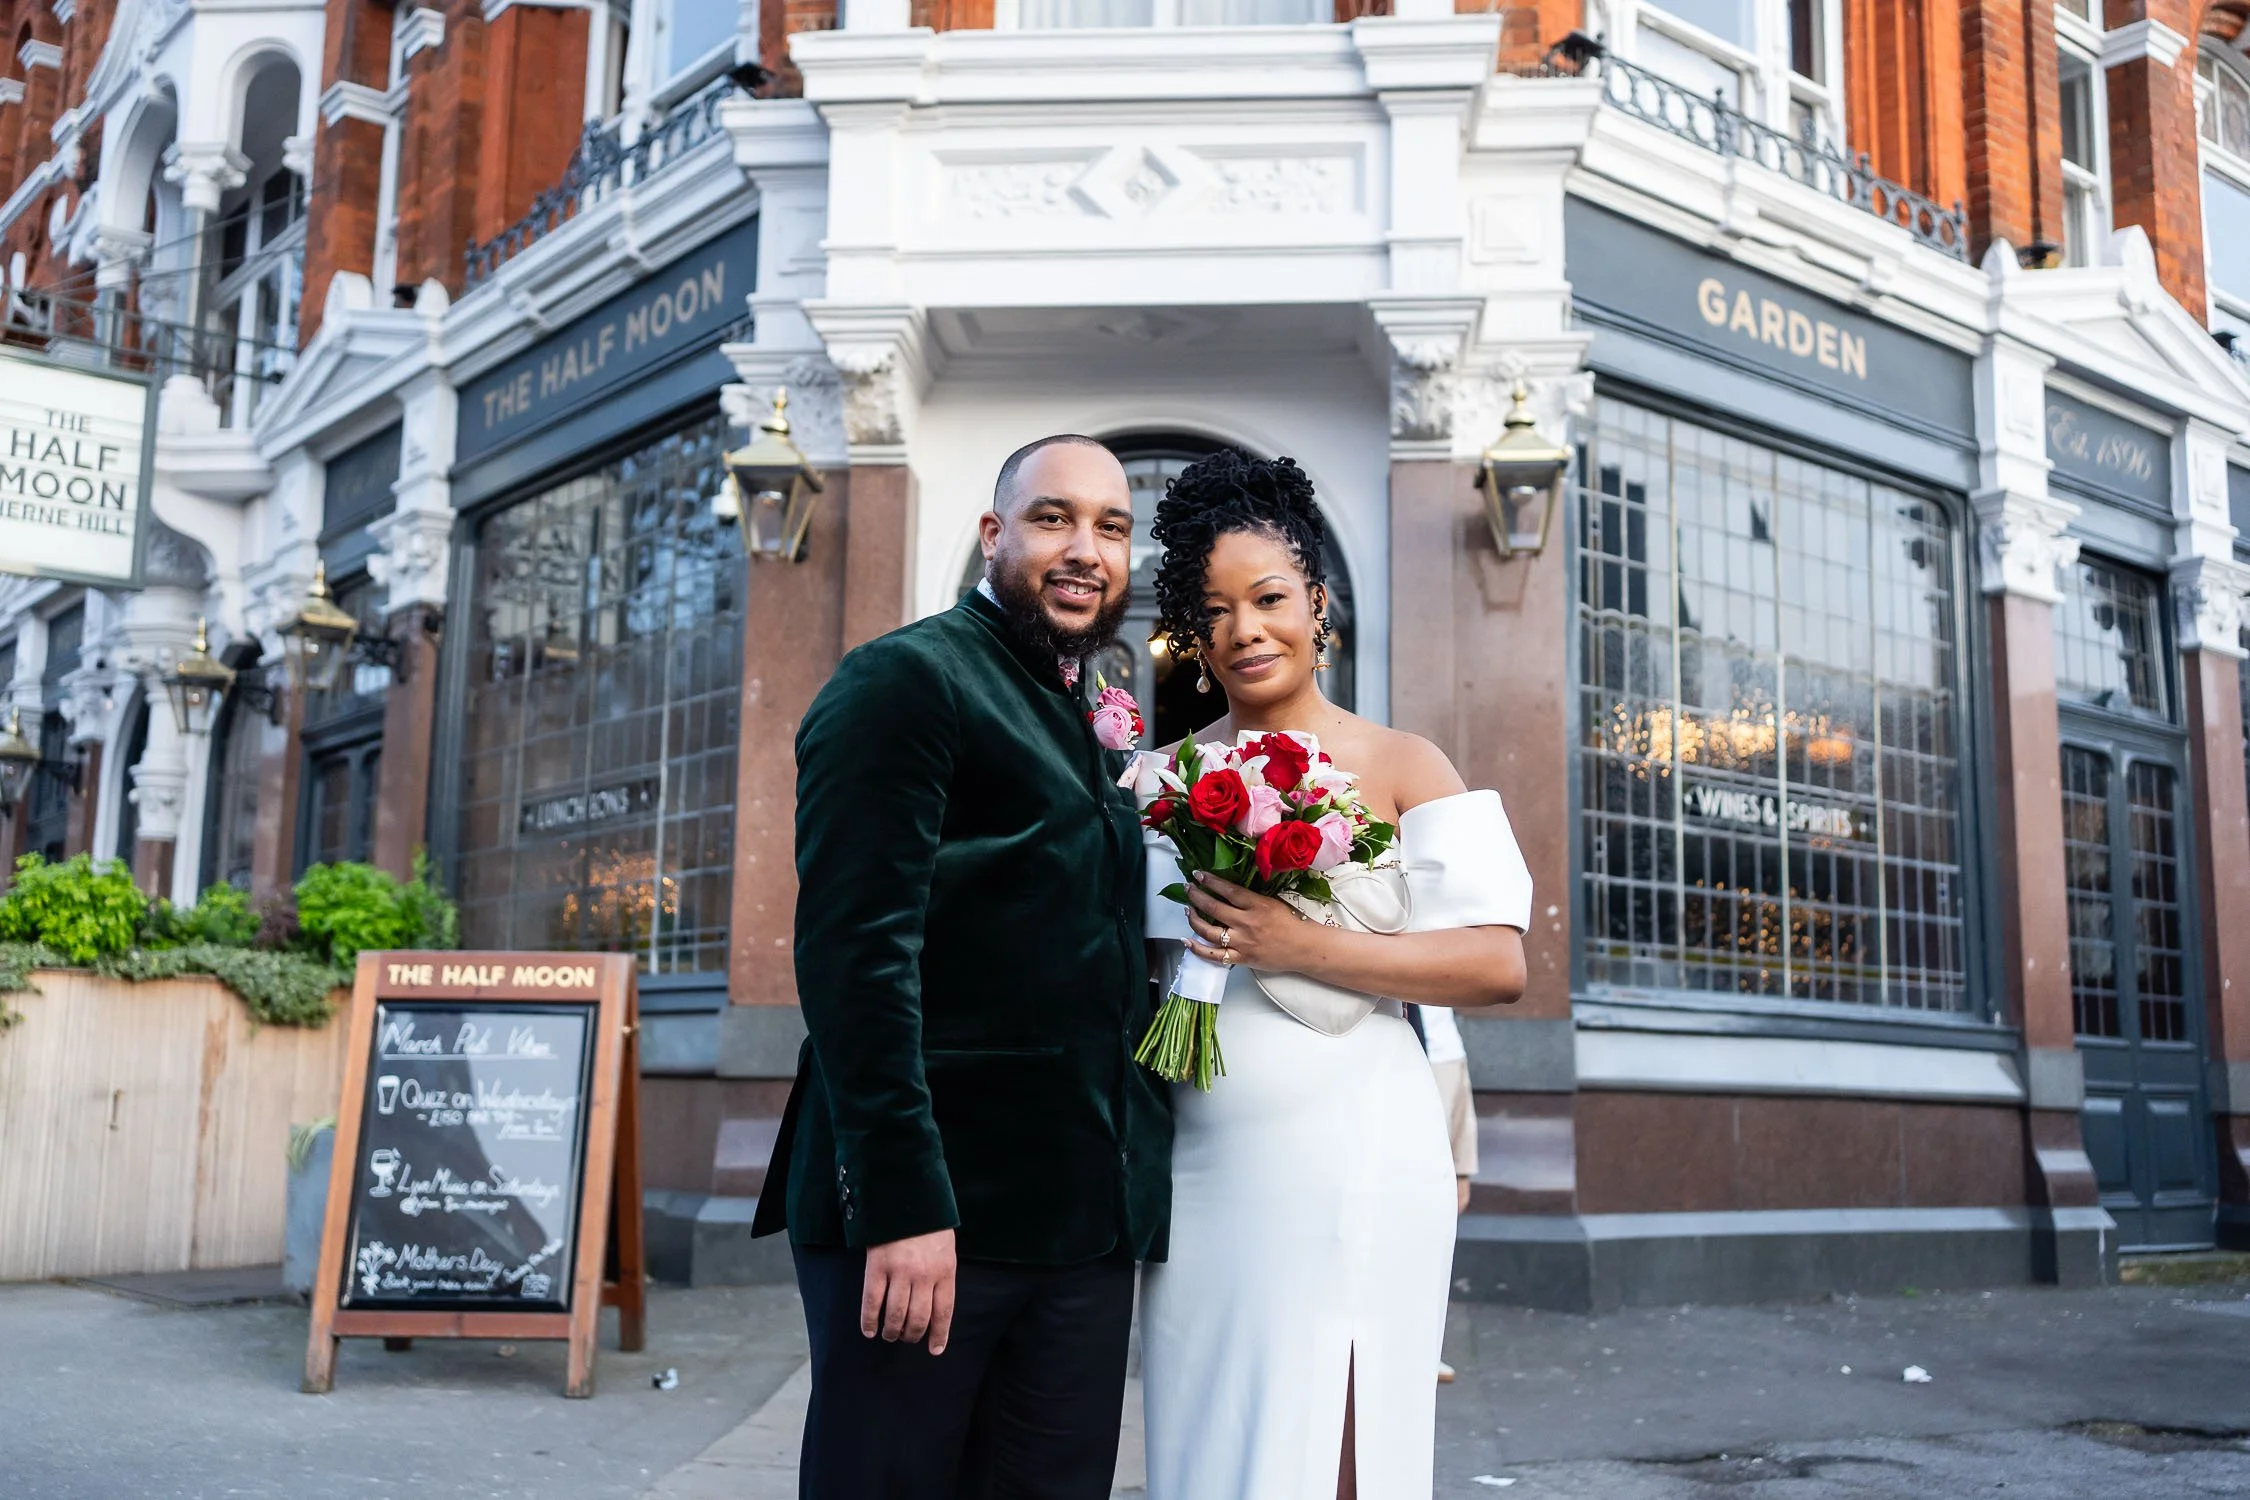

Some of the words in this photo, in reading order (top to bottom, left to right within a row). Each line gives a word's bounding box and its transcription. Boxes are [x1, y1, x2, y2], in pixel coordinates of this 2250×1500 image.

[482, 369, 534, 429] THE
[539, 322, 616, 399] HALF
[625, 260, 726, 352] MOON
[1697, 277, 1868, 381] GARDEN
[44, 408, 92, 434] THE
[10, 429, 121, 472] HALF
[2096, 433, 2153, 483] 1896
[0, 463, 126, 511] MOON
[0, 500, 70, 527] ERNE
[77, 512, 126, 537] HILL
[1696, 785, 1762, 825] WINES
[1762, 797, 1779, 827] &
[1787, 801, 1851, 838] SPIRITS
[387, 964, 434, 986] THE
[441, 965, 506, 987] HALF
[511, 965, 596, 988] MOON
[401, 1078, 449, 1110] Quiz
[451, 1092, 475, 1110] on
